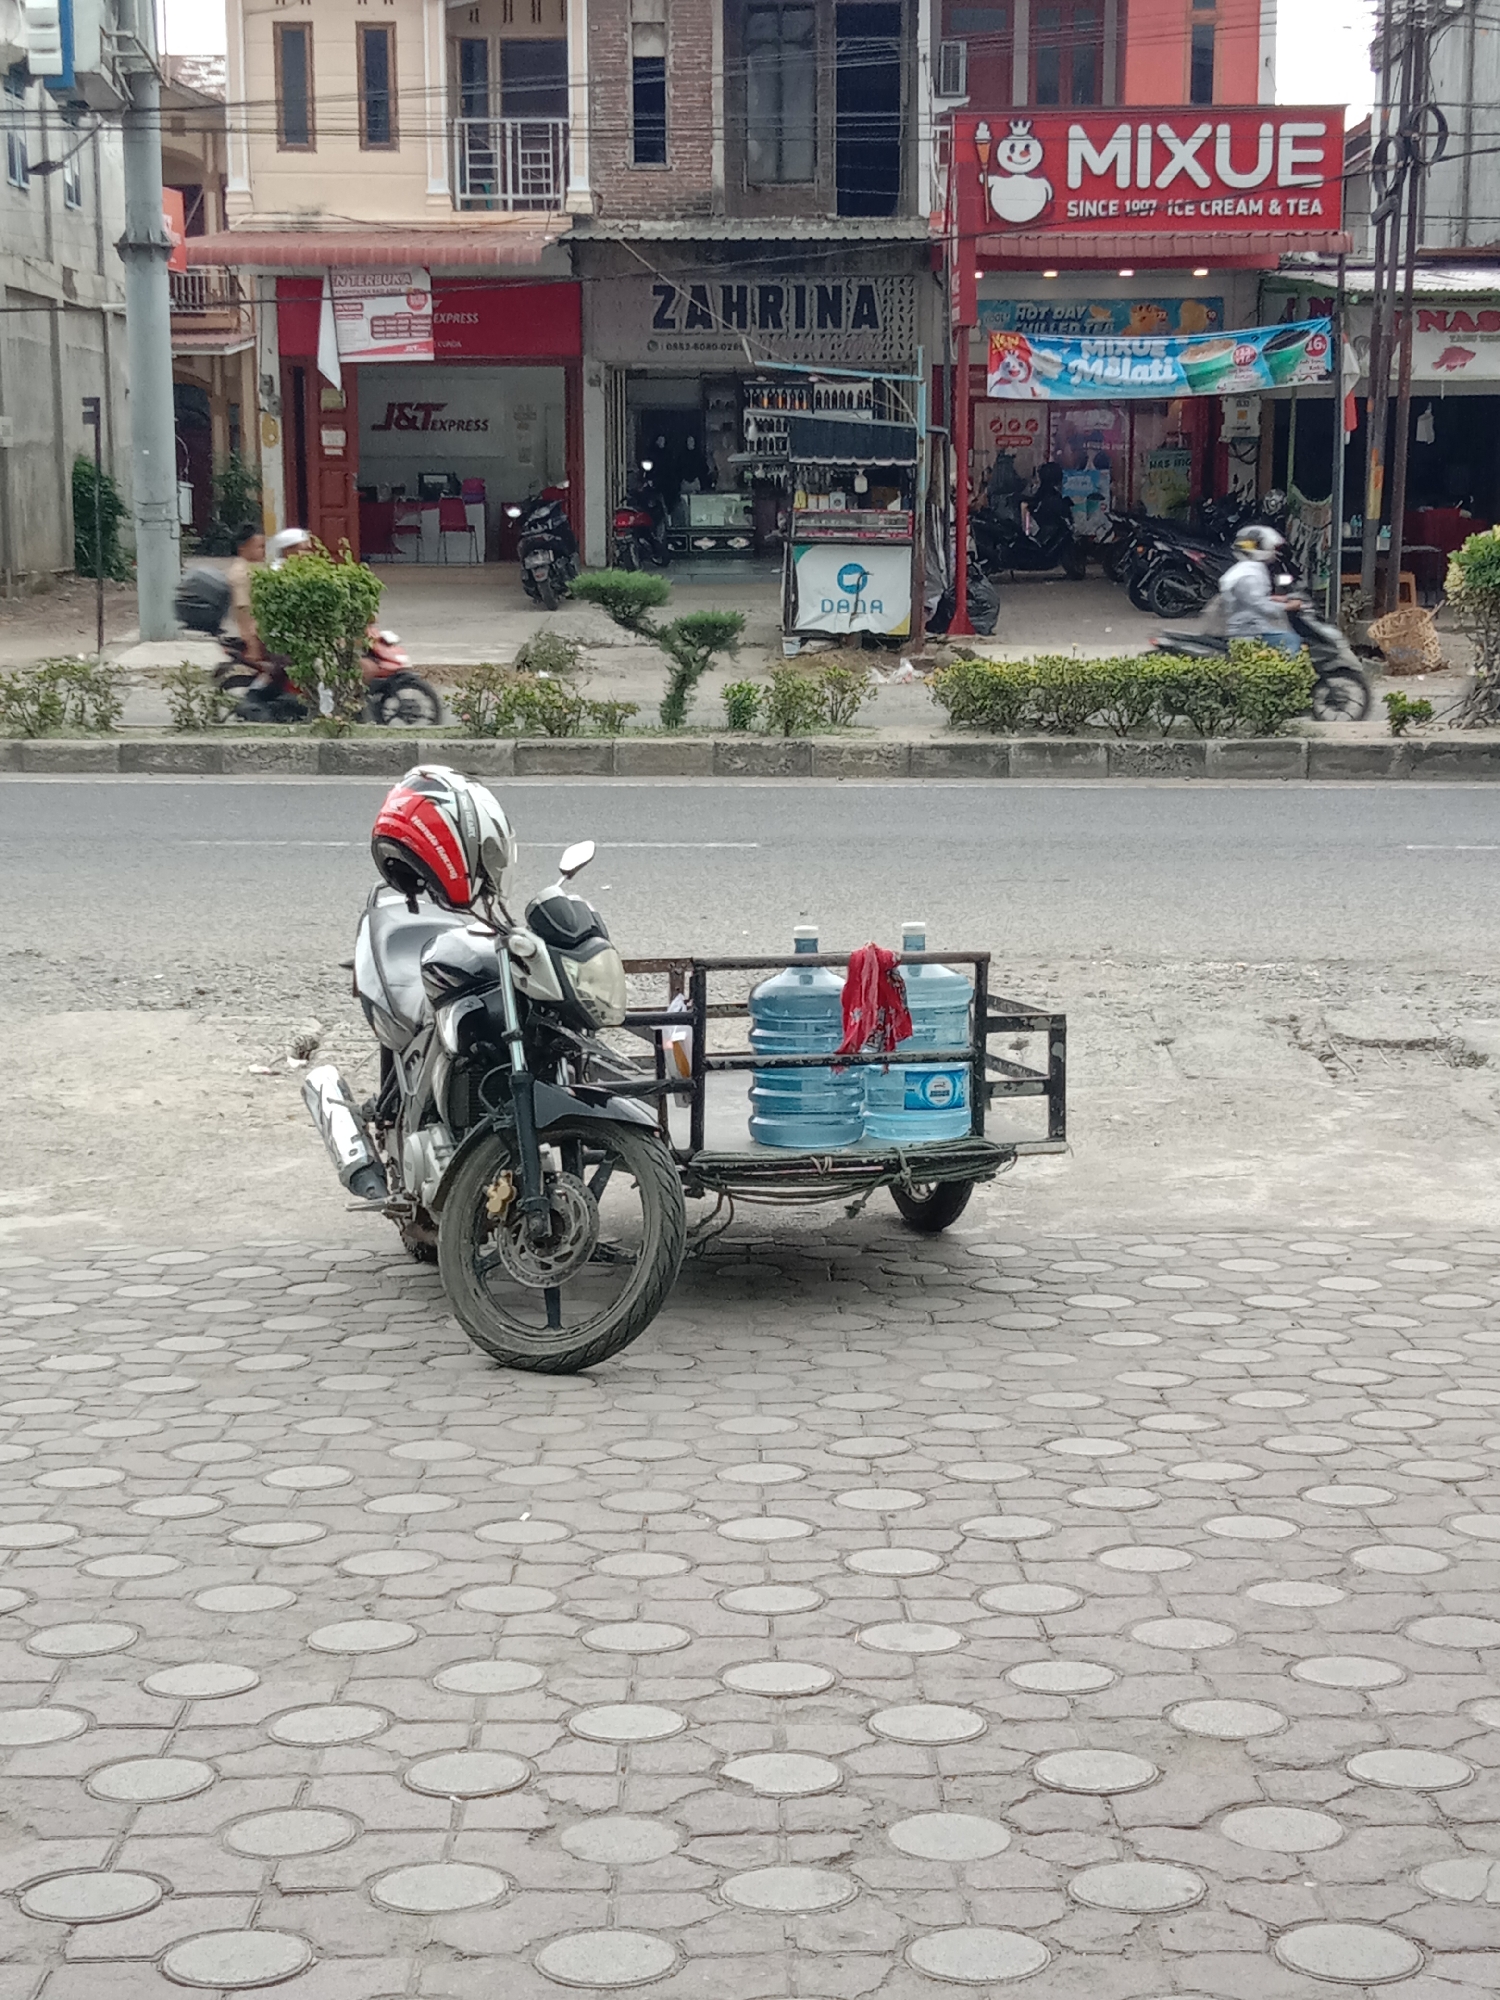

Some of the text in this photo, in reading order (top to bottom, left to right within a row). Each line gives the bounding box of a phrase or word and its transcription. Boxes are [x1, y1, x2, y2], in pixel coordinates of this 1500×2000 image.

[1066, 122, 1327, 190] MIXUE
[1066, 198, 1324, 218] SINCE 1997 ICE CREAM & TEA
[350, 272, 413, 287] TERBUKA
[651, 283, 881, 331] ZAHRINA
[1014, 302, 1053, 321] HOT
[1049, 304, 1088, 320] DAY
[433, 312, 480, 325] EXPRESS
[1080, 340, 1170, 360] MIXUE
[371, 402, 490, 432] J&T EXPRESS
[820, 598, 884, 615] DANA
